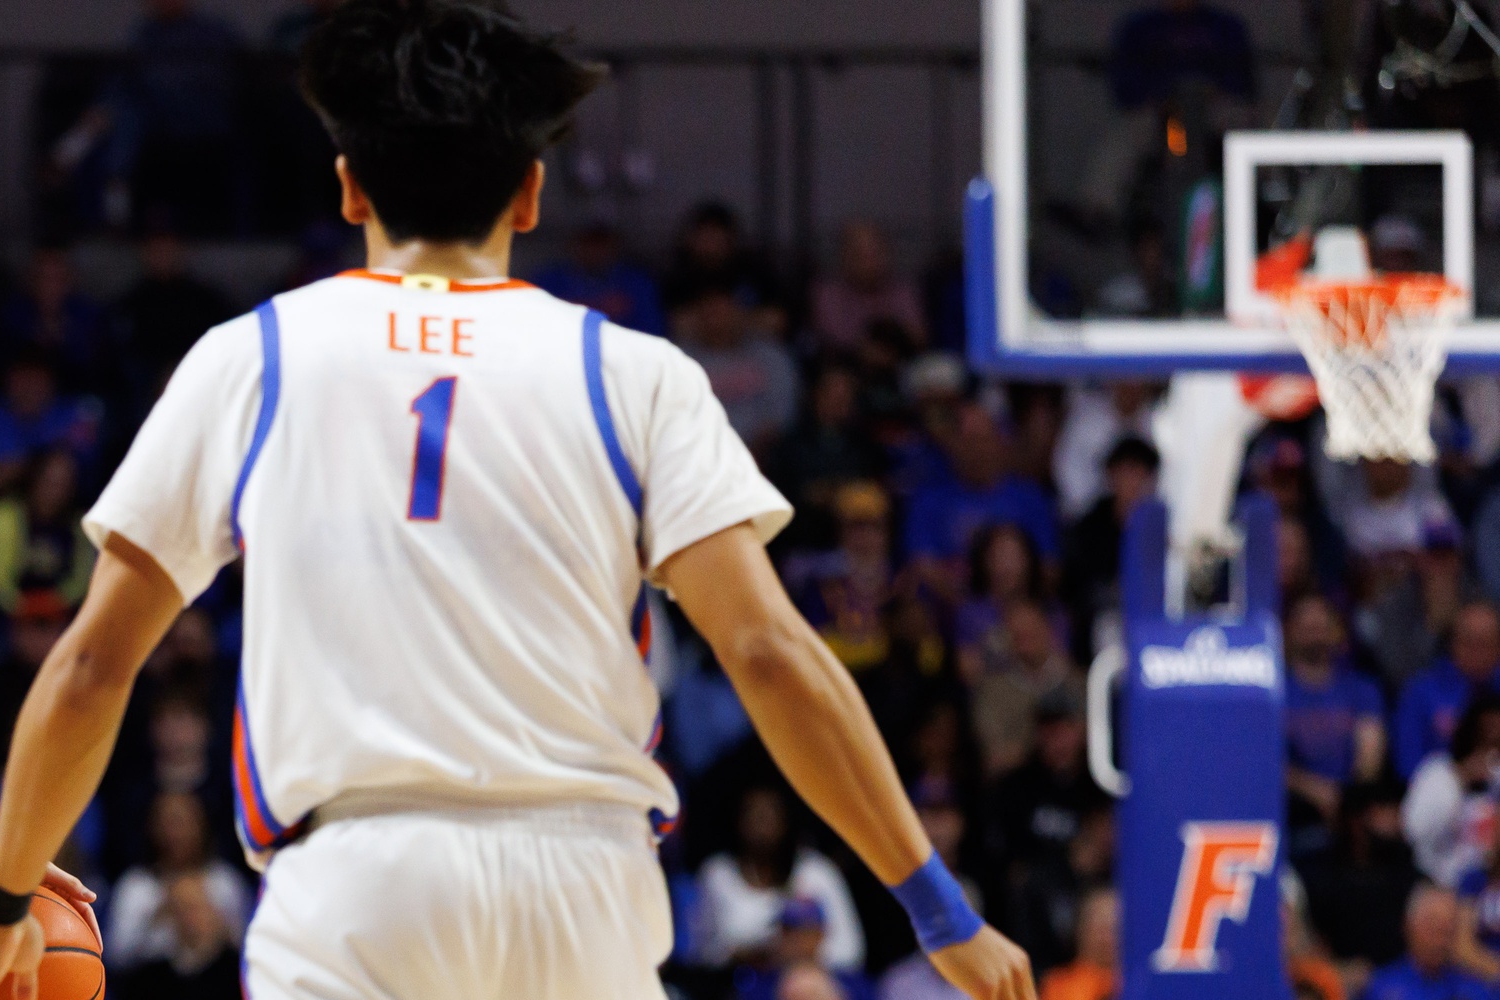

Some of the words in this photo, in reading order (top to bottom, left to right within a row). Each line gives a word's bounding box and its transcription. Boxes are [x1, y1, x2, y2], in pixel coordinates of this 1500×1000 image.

[387, 311, 475, 357] LEE
[407, 376, 458, 521] 1
[1153, 820, 1280, 974] F
